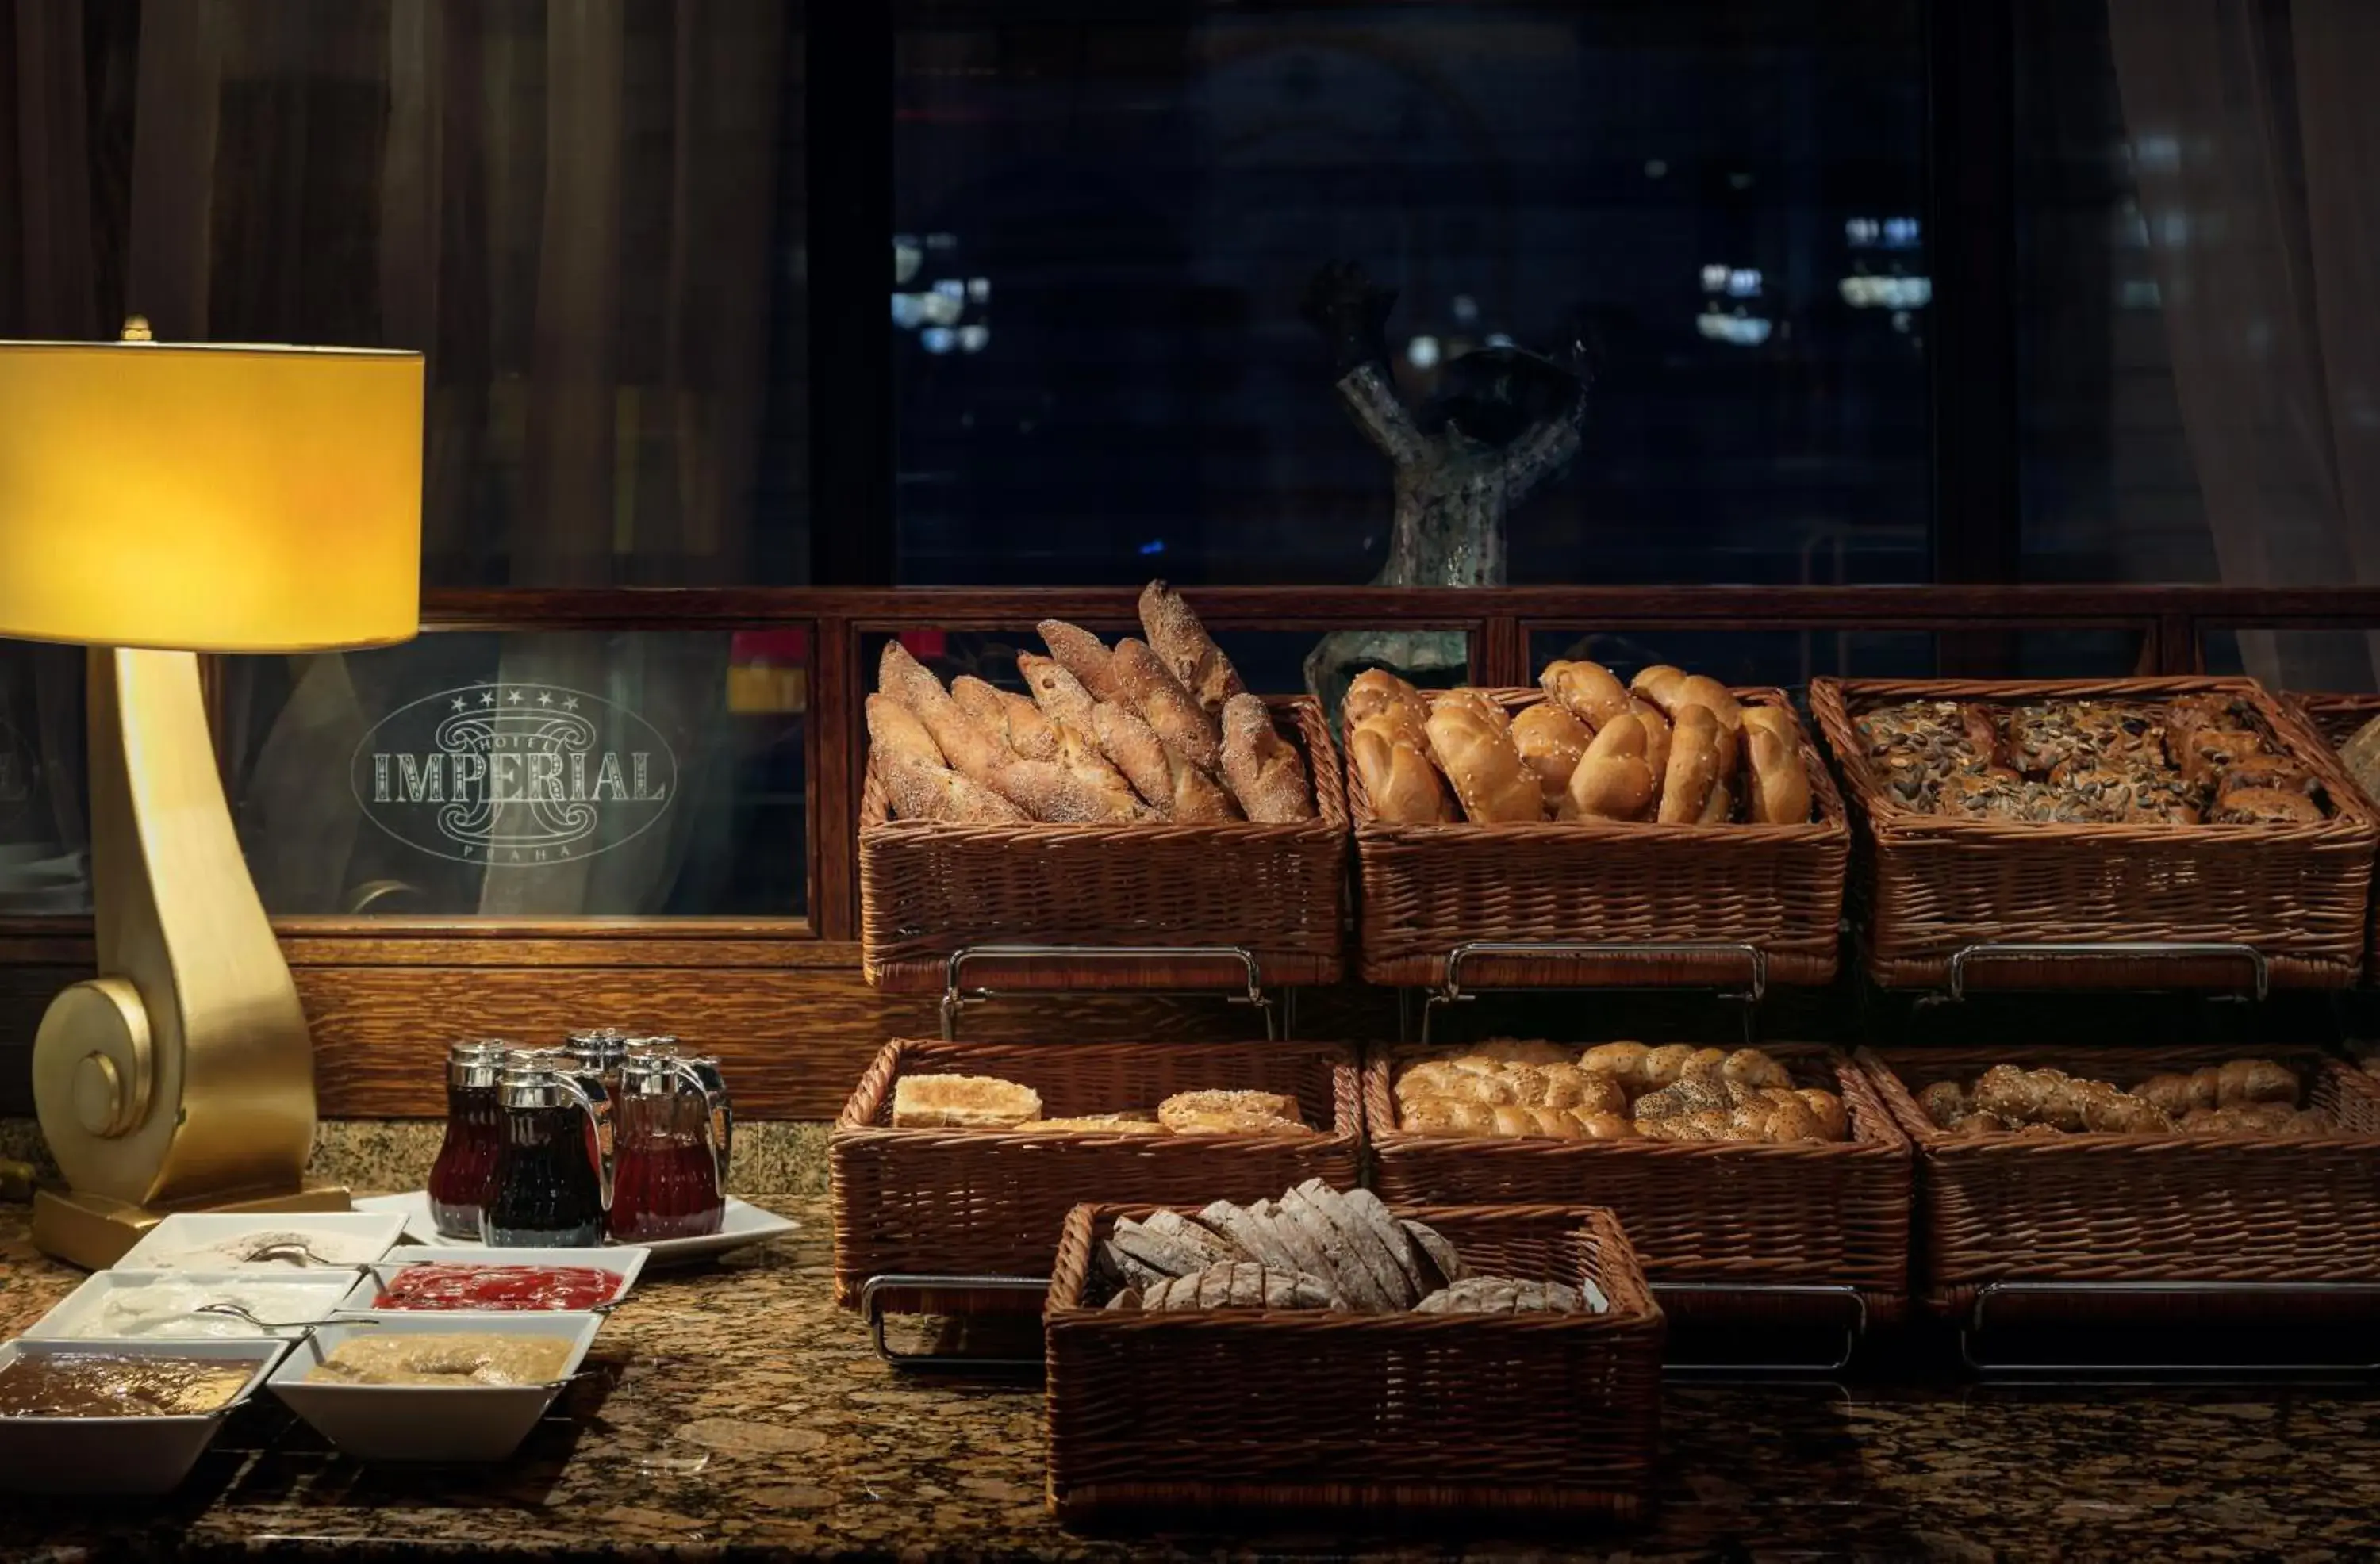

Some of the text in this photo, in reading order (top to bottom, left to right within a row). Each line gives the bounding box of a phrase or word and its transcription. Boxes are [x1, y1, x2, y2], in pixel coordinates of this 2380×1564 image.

[478, 736, 550, 752] HOTEL
[372, 752, 666, 802] IMPERIAL
[463, 845, 570, 861] PRAHA
